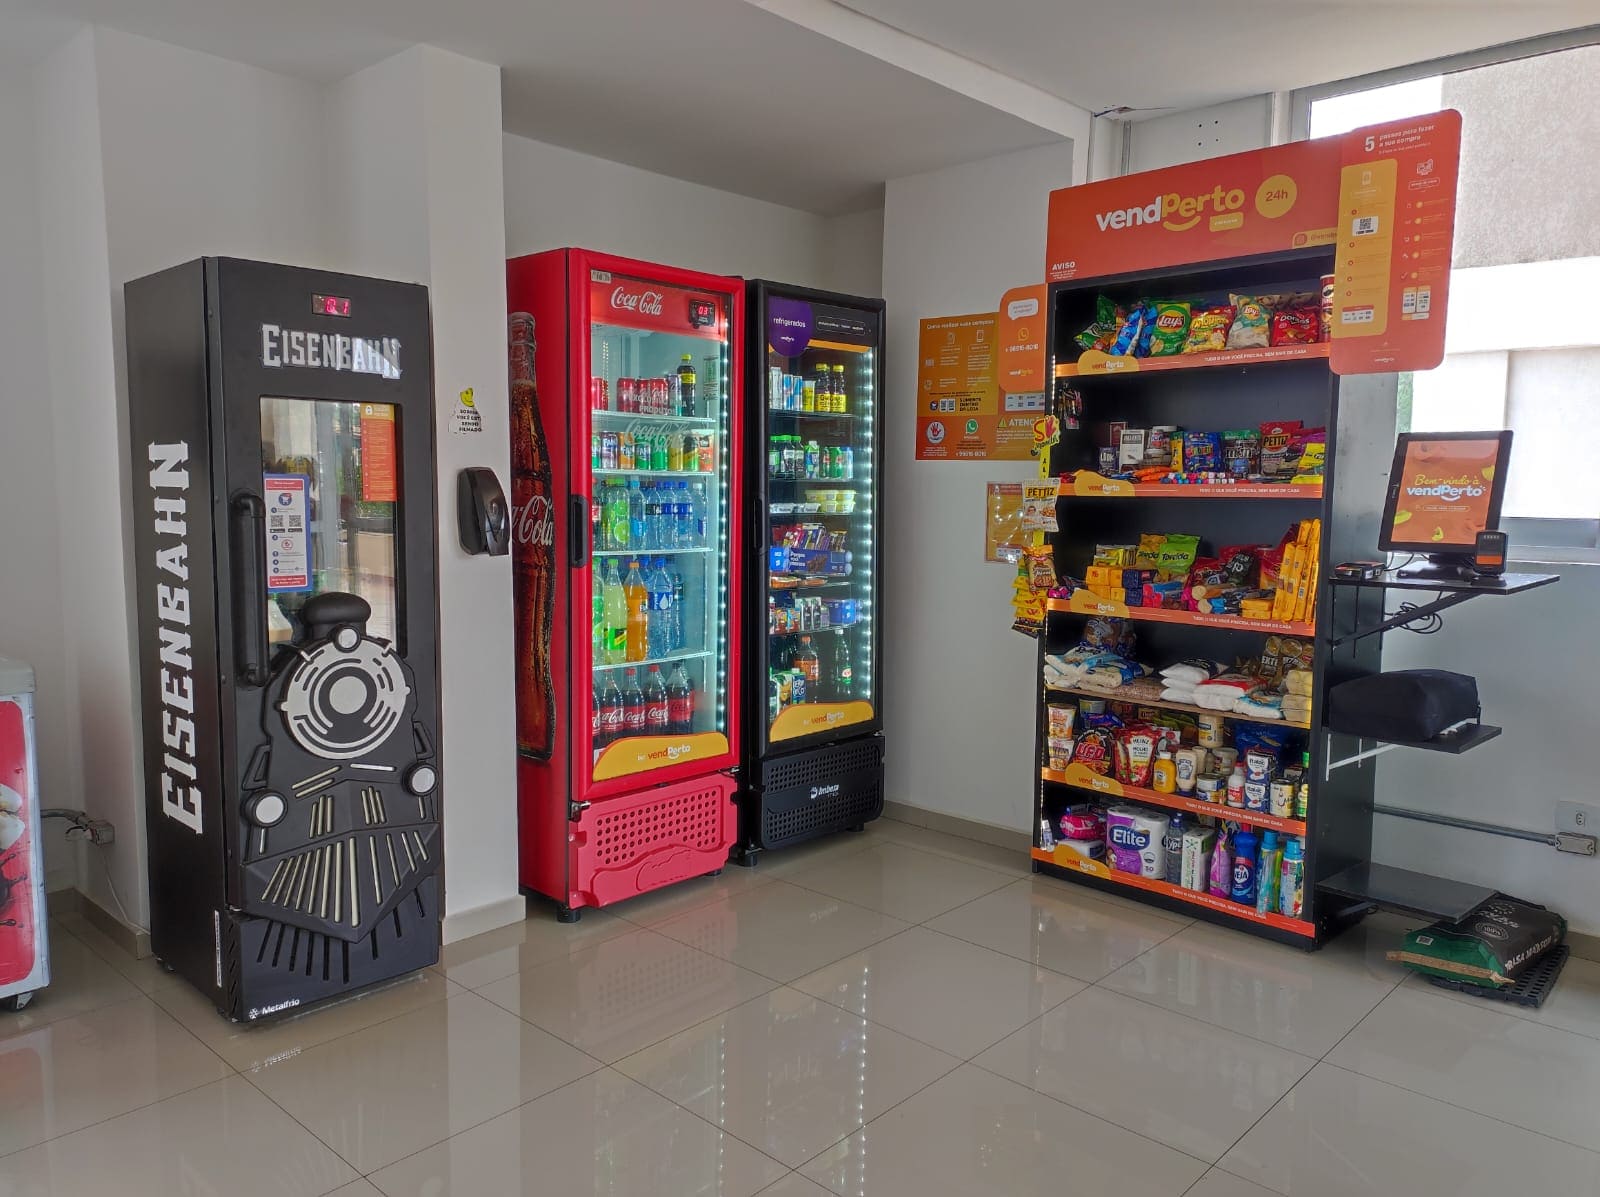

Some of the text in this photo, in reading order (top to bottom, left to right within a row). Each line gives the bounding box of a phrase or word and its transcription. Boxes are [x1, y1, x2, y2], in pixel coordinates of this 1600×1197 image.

[1365, 136, 1375, 152] 5
[1265, 189, 1289, 202] 24h
[1095, 185, 1246, 232] vendPerto
[1052, 261, 1076, 271] AVISO
[262, 323, 401, 379] EISENBAHN
[1027, 487, 1055, 497] PETTIZ
[1406, 484, 1483, 500] vendPerto
[148, 440, 203, 835] EISENBAHN
[648, 744, 691, 759] vendPerto
[1113, 829, 1146, 847] Elite
[261, 998, 300, 1015] Metalfrio
